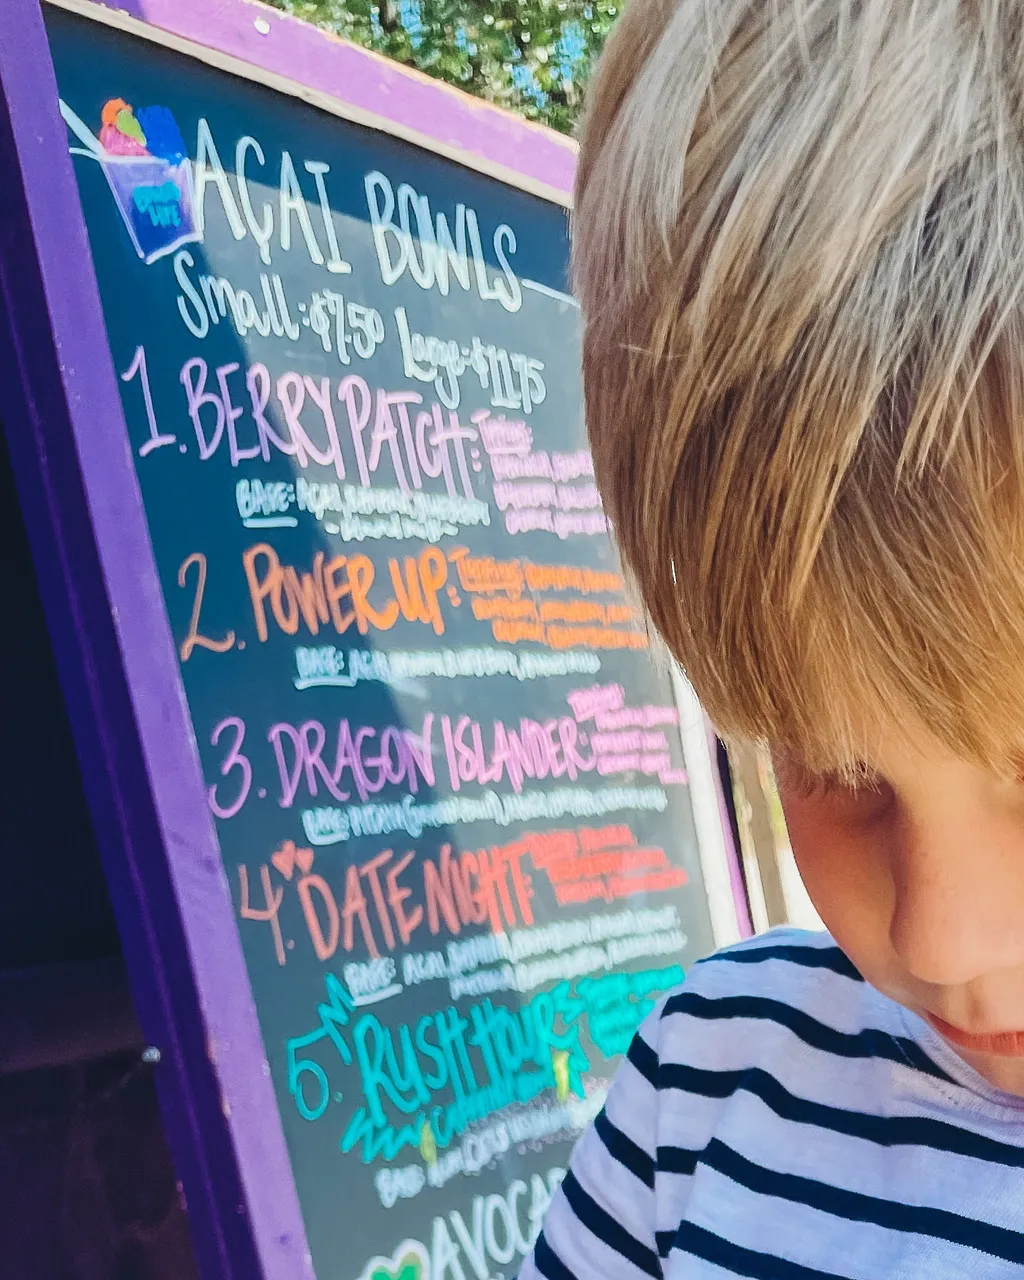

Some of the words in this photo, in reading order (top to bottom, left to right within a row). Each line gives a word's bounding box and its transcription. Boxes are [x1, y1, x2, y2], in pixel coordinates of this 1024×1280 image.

[364, 169, 523, 313] BOWLS
[121, 344, 187, 457] 1.
[180, 357, 346, 480] BERRY
[178, 552, 246, 662] 2.
[242, 542, 399, 643] POWER
[388, 546, 462, 637] UP:
[207, 716, 267, 819] 3.
[268, 711, 436, 808] DRAGON
[239, 863, 295, 966] 4.
[296, 848, 423, 961] DATE
[352, 1006, 479, 1128] RUSH
